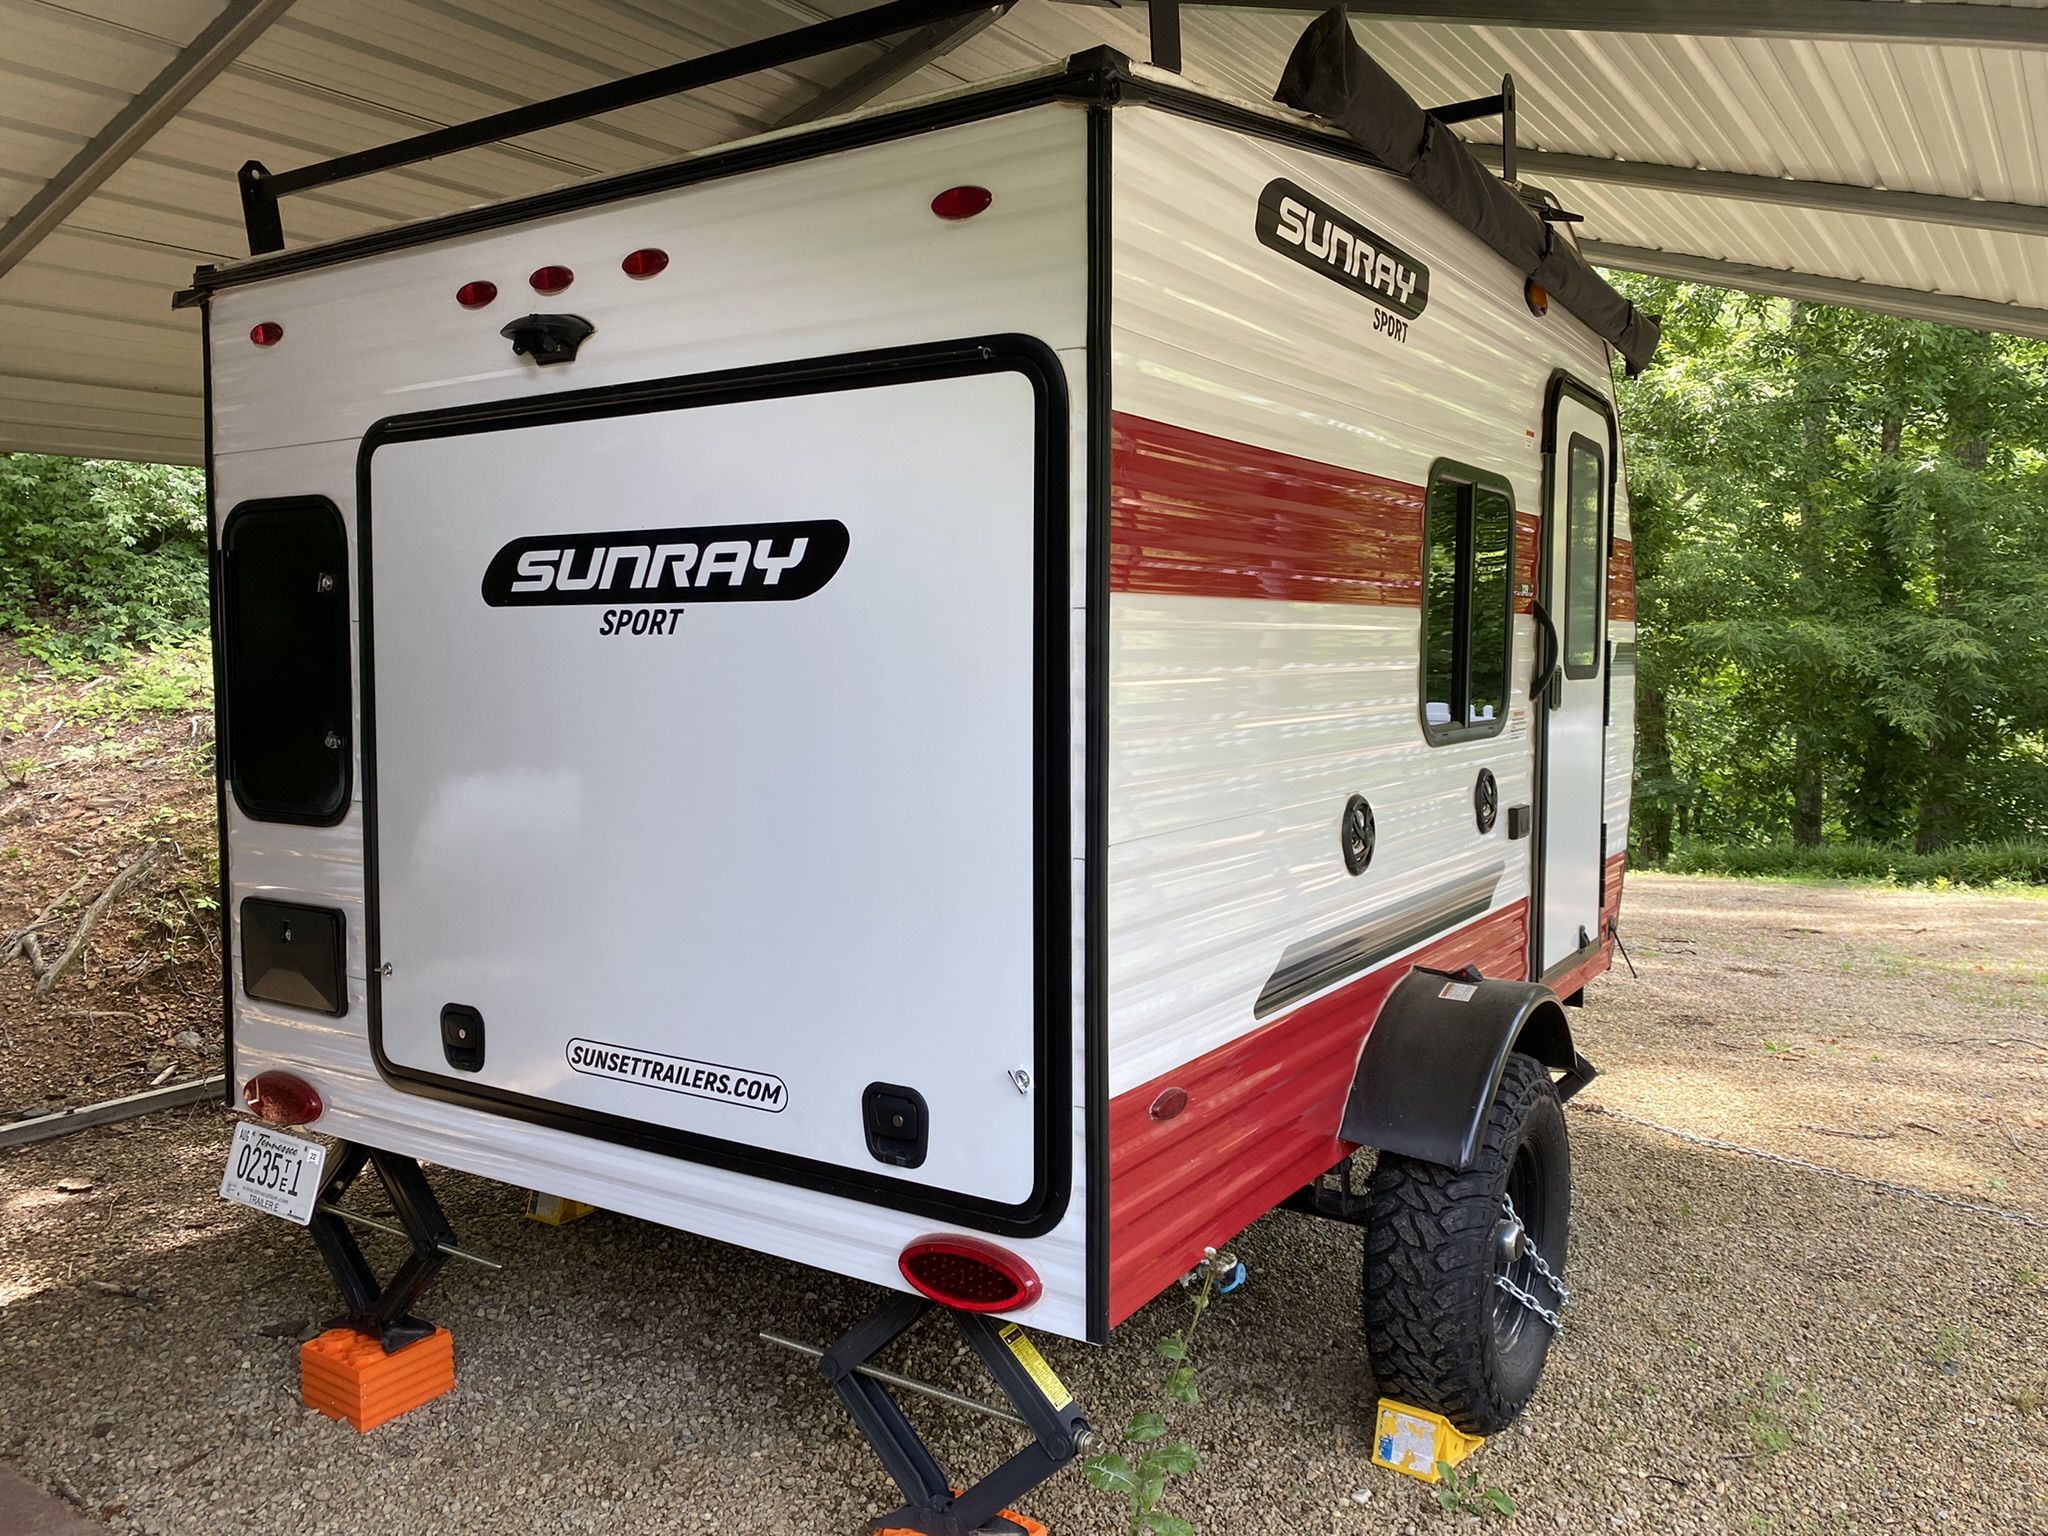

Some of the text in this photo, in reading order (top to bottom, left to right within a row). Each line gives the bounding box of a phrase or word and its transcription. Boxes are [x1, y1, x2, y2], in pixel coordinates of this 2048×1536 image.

[1276, 196, 1417, 304] SUNRAY
[1373, 307, 1409, 343] SPORT
[511, 537, 809, 593] SUNRAY
[599, 608, 685, 636] SPORT
[571, 1046, 782, 1104] SUNSETTRAILERS.COM
[255, 1133, 298, 1156] Tennessee
[248, 1194, 274, 1210] TRAILER
